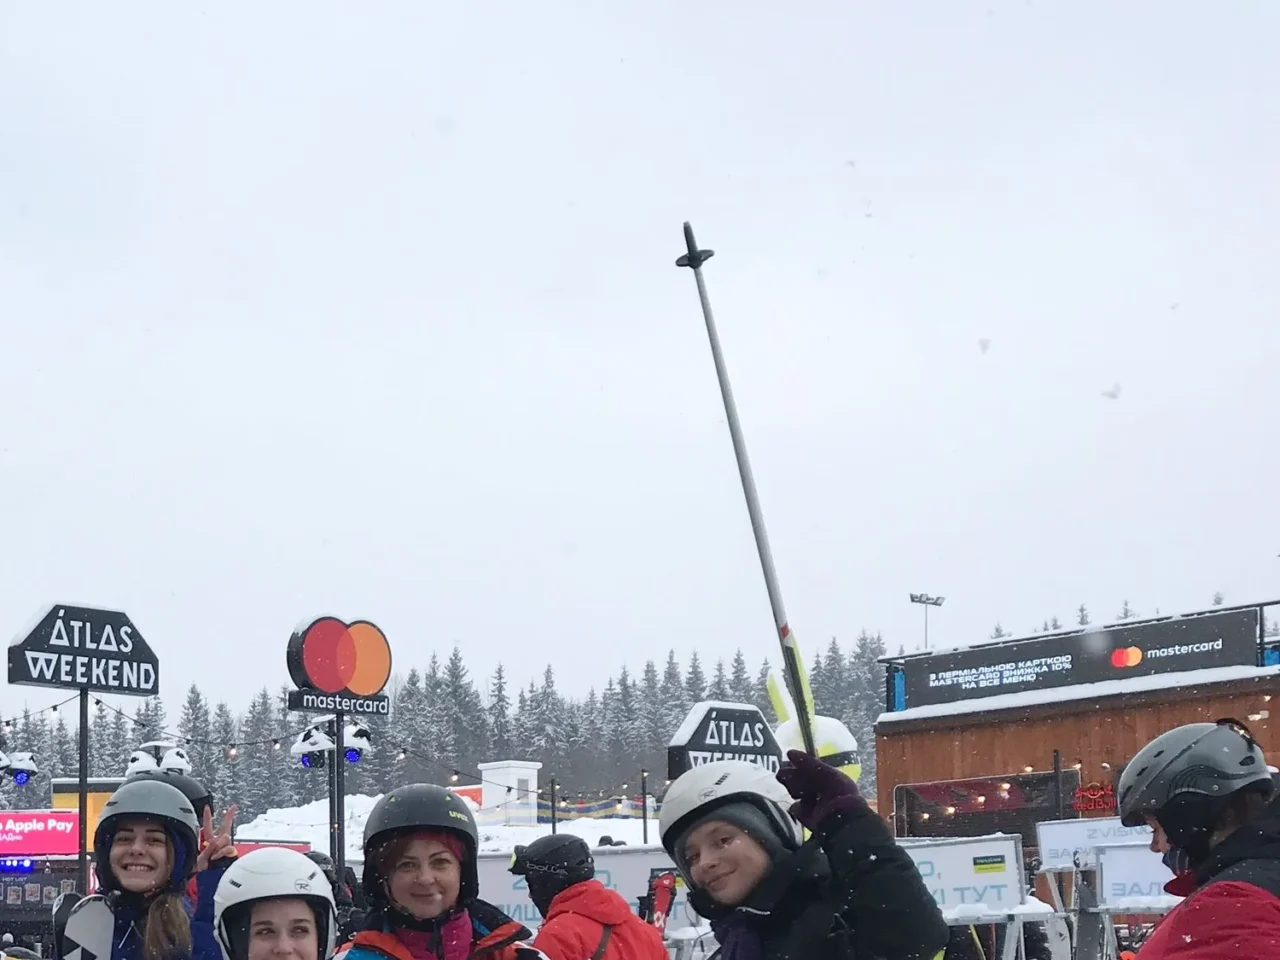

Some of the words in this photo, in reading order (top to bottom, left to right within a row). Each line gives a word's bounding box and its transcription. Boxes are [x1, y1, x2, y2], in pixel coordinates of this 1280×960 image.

[1147, 638, 1223, 659] mastercard
[24, 650, 156, 690] WEEKEND
[1019, 654, 1072, 668] КАРТКОЮ
[929, 672, 1000, 687] MASTERCARD
[1003, 664, 1049, 678] ЗНИЖКА
[1051, 662, 1072, 671] 10%
[962, 681, 977, 690] НА
[980, 679, 1000, 688] ВСЕ
[1003, 673, 1037, 685] МЕНЮ
[303, 694, 388, 713] mastercard
[5, 818, 45, 833] Apple
[47, 818, 73, 833] Pay
[952, 884, 1008, 904] ТУТ
